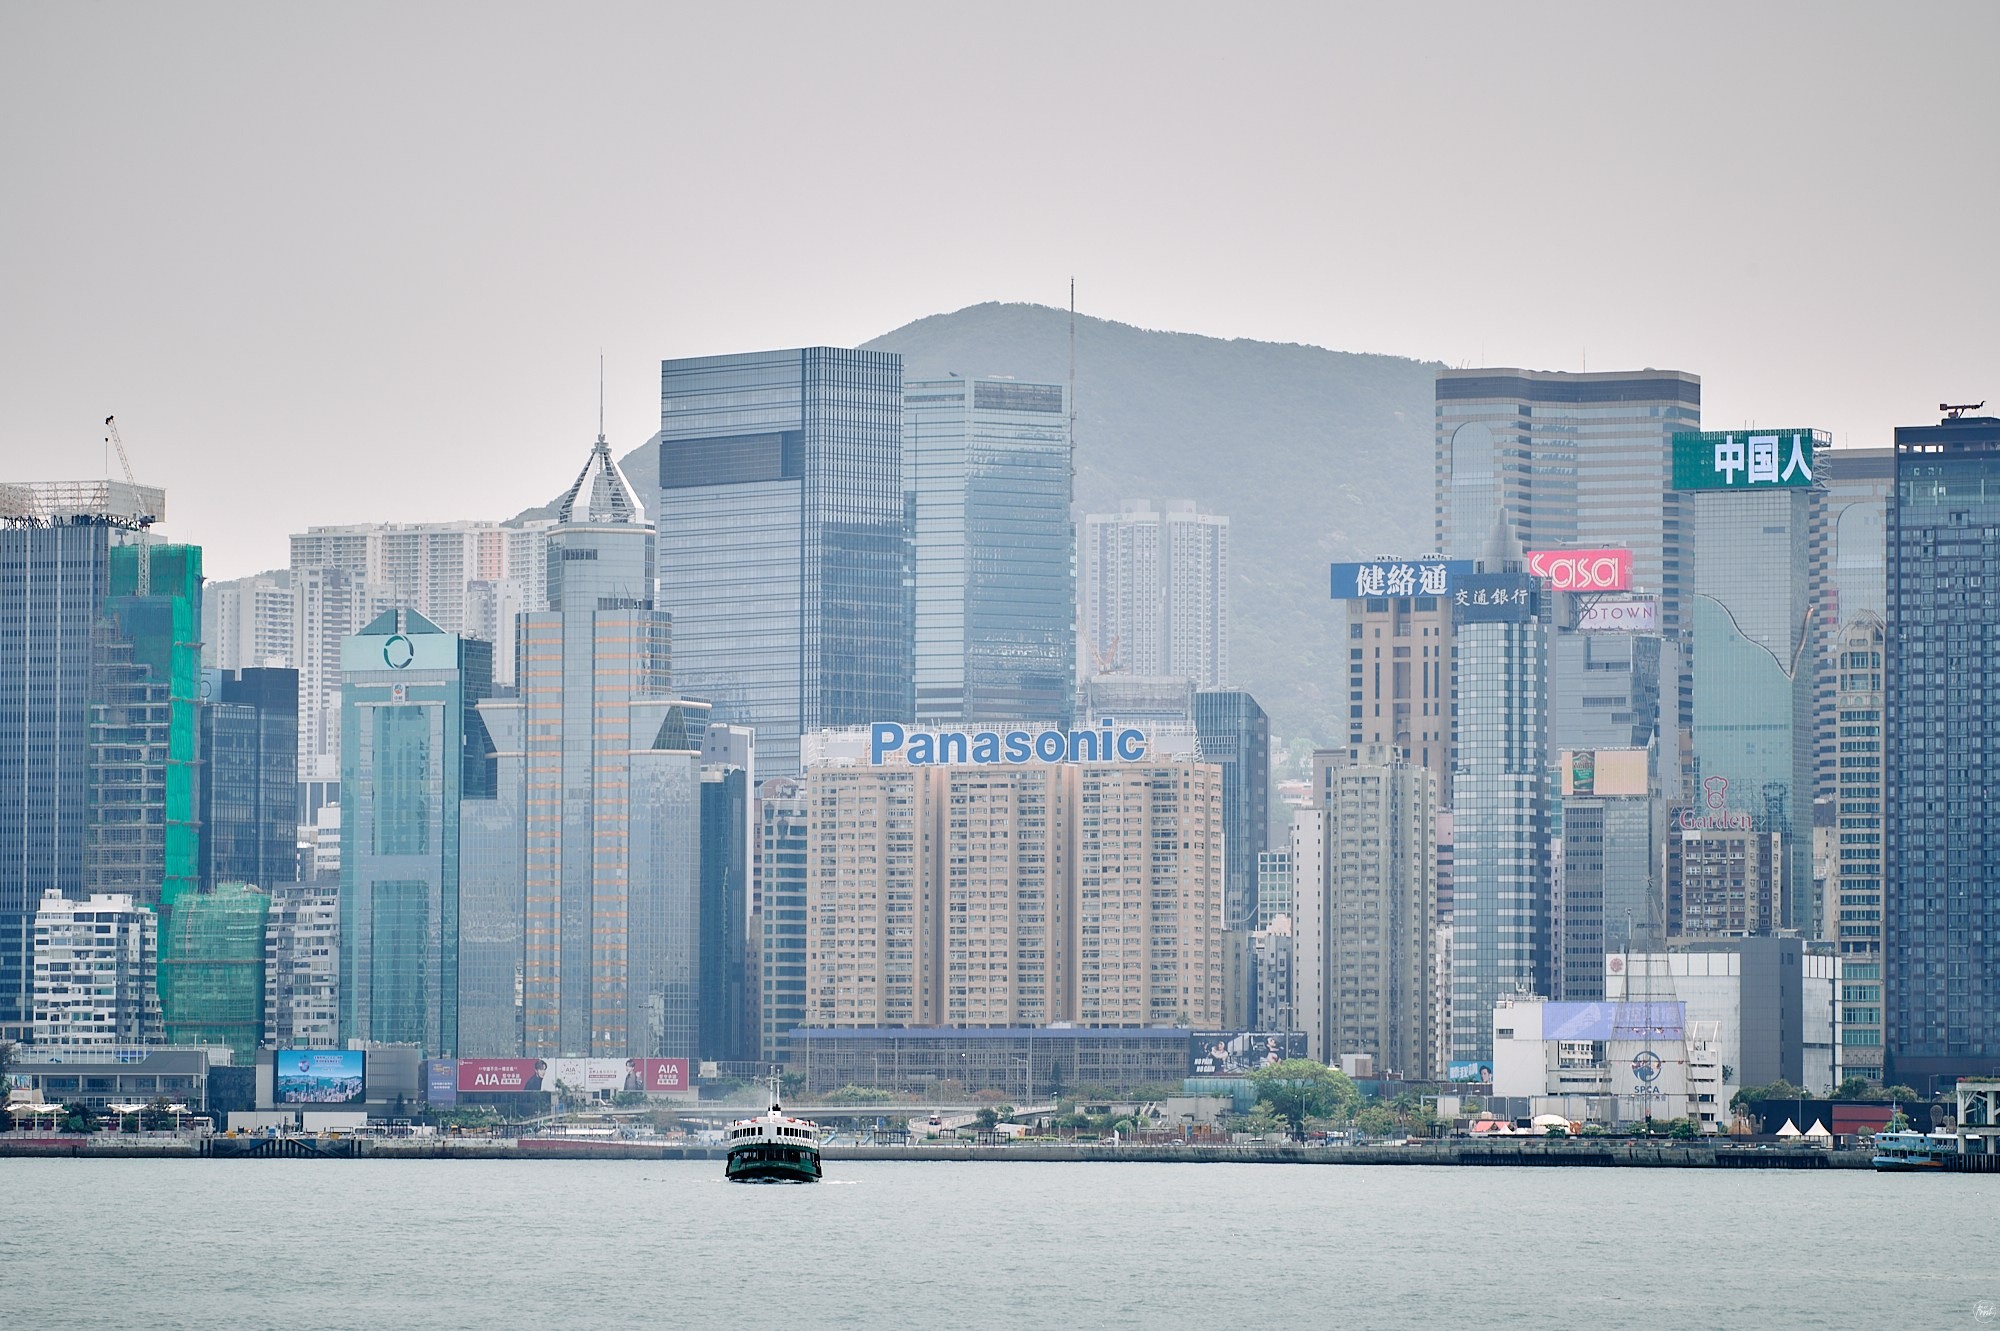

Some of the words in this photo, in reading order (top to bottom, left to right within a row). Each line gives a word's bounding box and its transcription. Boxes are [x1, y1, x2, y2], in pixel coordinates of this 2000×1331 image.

[1714, 434, 1812, 484] 中国人
[1355, 563, 1449, 597] 健絡通
[1455, 588, 1529, 606] 交通銀行
[871, 717, 1147, 766] Panasonic
[1680, 809, 1753, 829] Garden
[658, 1064, 679, 1074] AIA
[474, 1073, 500, 1086] AIA
[1634, 1085, 1660, 1093] SPCA
